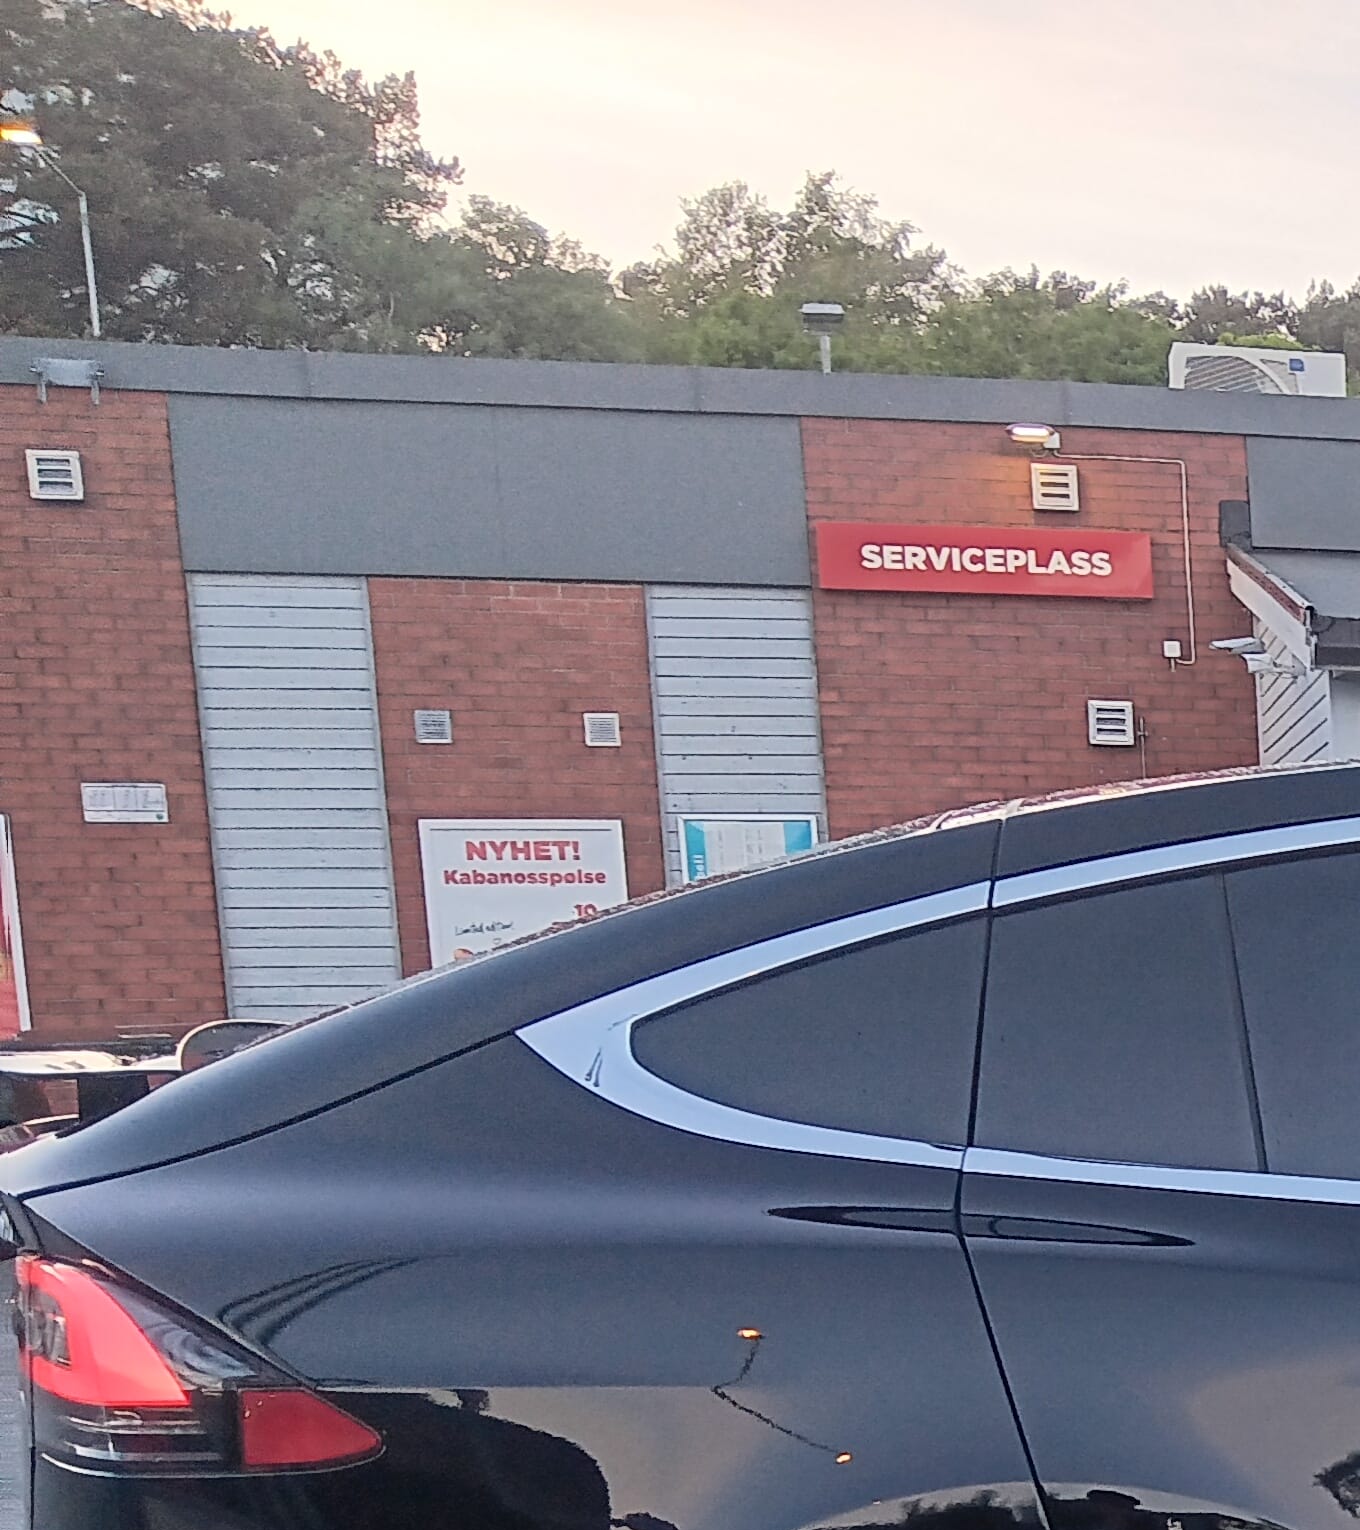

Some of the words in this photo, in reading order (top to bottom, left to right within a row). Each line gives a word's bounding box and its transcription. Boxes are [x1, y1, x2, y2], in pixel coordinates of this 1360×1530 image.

[861, 544, 1112, 576] SERVICEPLASS
[465, 841, 581, 861] NYHET!
[443, 869, 607, 887] Kabanosspølse
